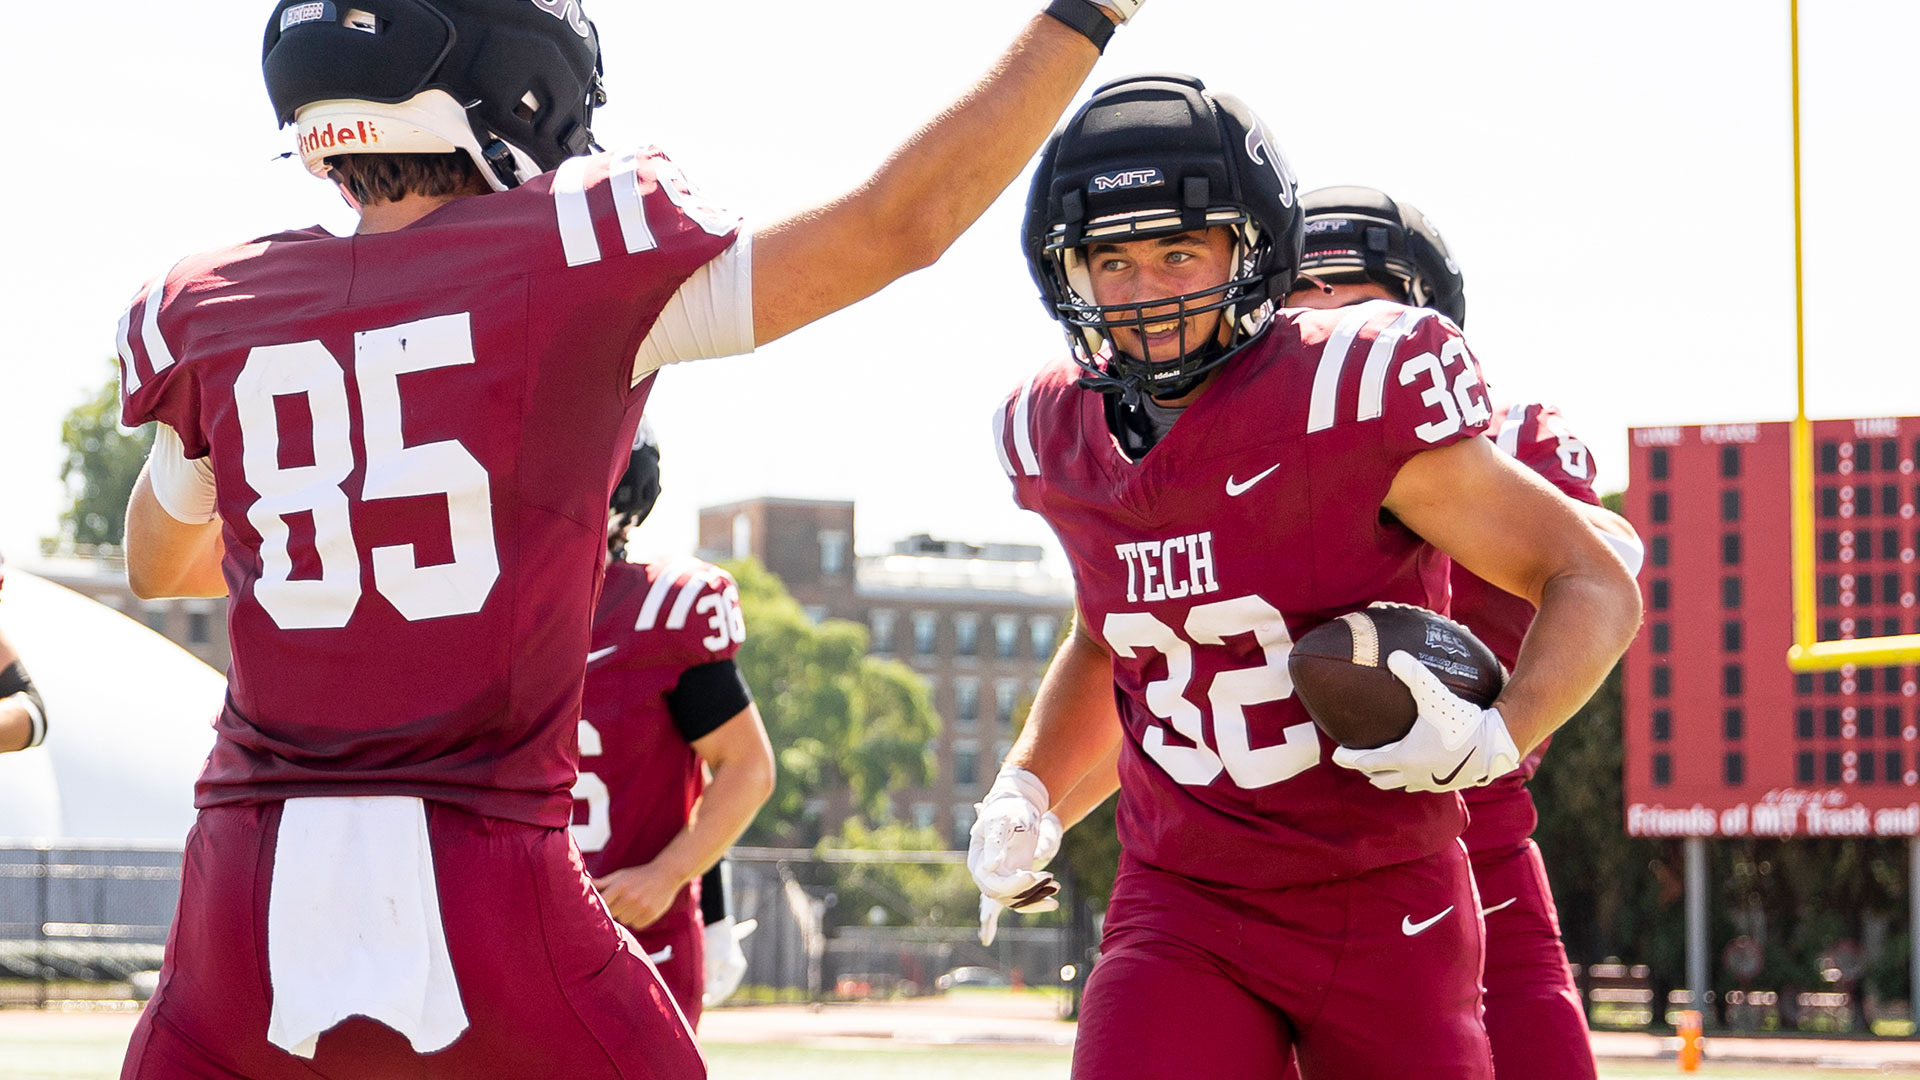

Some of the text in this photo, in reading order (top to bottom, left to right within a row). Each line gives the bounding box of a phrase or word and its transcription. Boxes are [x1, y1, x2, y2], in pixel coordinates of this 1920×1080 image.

[1095, 170, 1156, 190] MIT
[1398, 337, 1492, 443] 32
[233, 311, 501, 630] 85
[1115, 531, 1219, 602] TECH
[696, 584, 746, 652] 36
[1102, 594, 1321, 789] 32
[1628, 804, 1717, 835] Friends
[1720, 804, 1748, 835] of
[1752, 804, 1797, 835] MIT
[1806, 804, 1870, 835] Track
